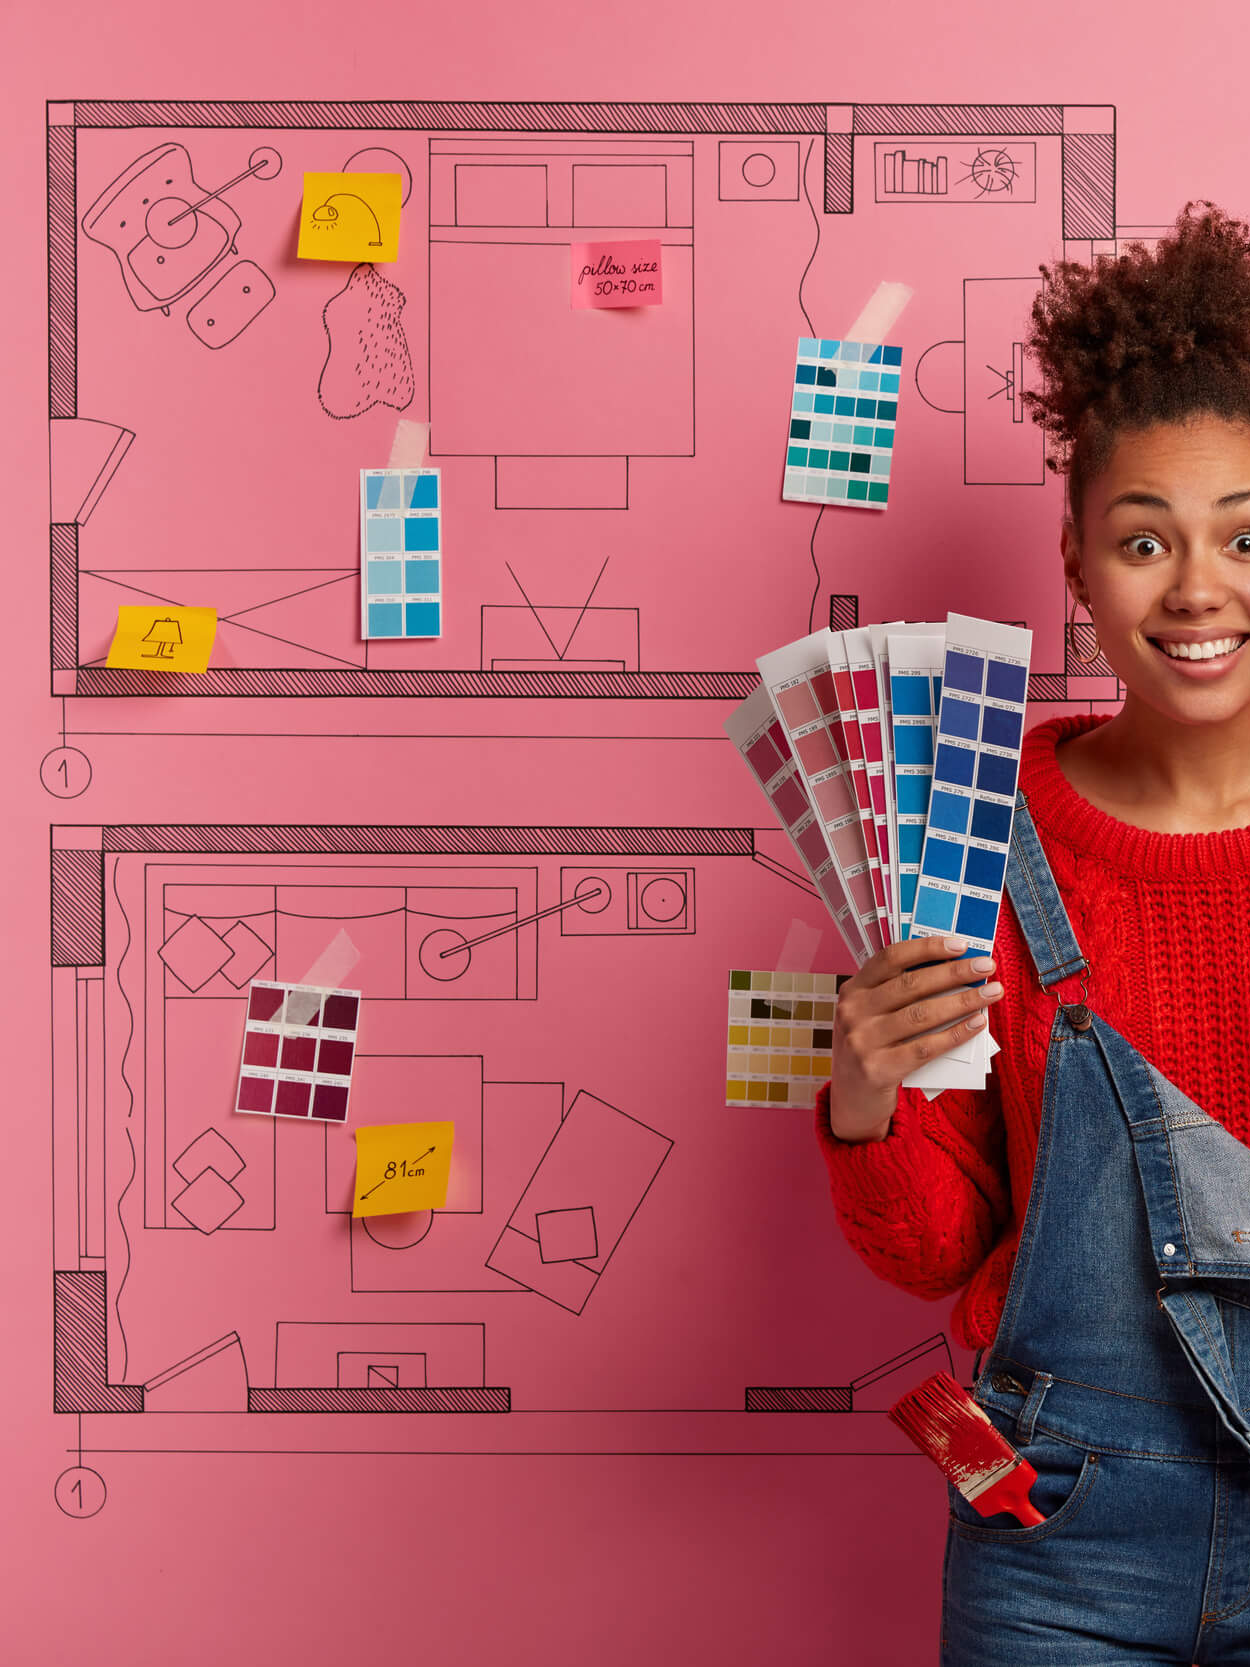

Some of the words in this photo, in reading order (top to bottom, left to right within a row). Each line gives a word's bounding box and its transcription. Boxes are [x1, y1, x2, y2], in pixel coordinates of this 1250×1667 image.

[577, 255, 626, 285] pillow
[631, 256, 658, 274] size
[57, 759, 69, 789] 1
[71, 1479, 83, 1509] 1
